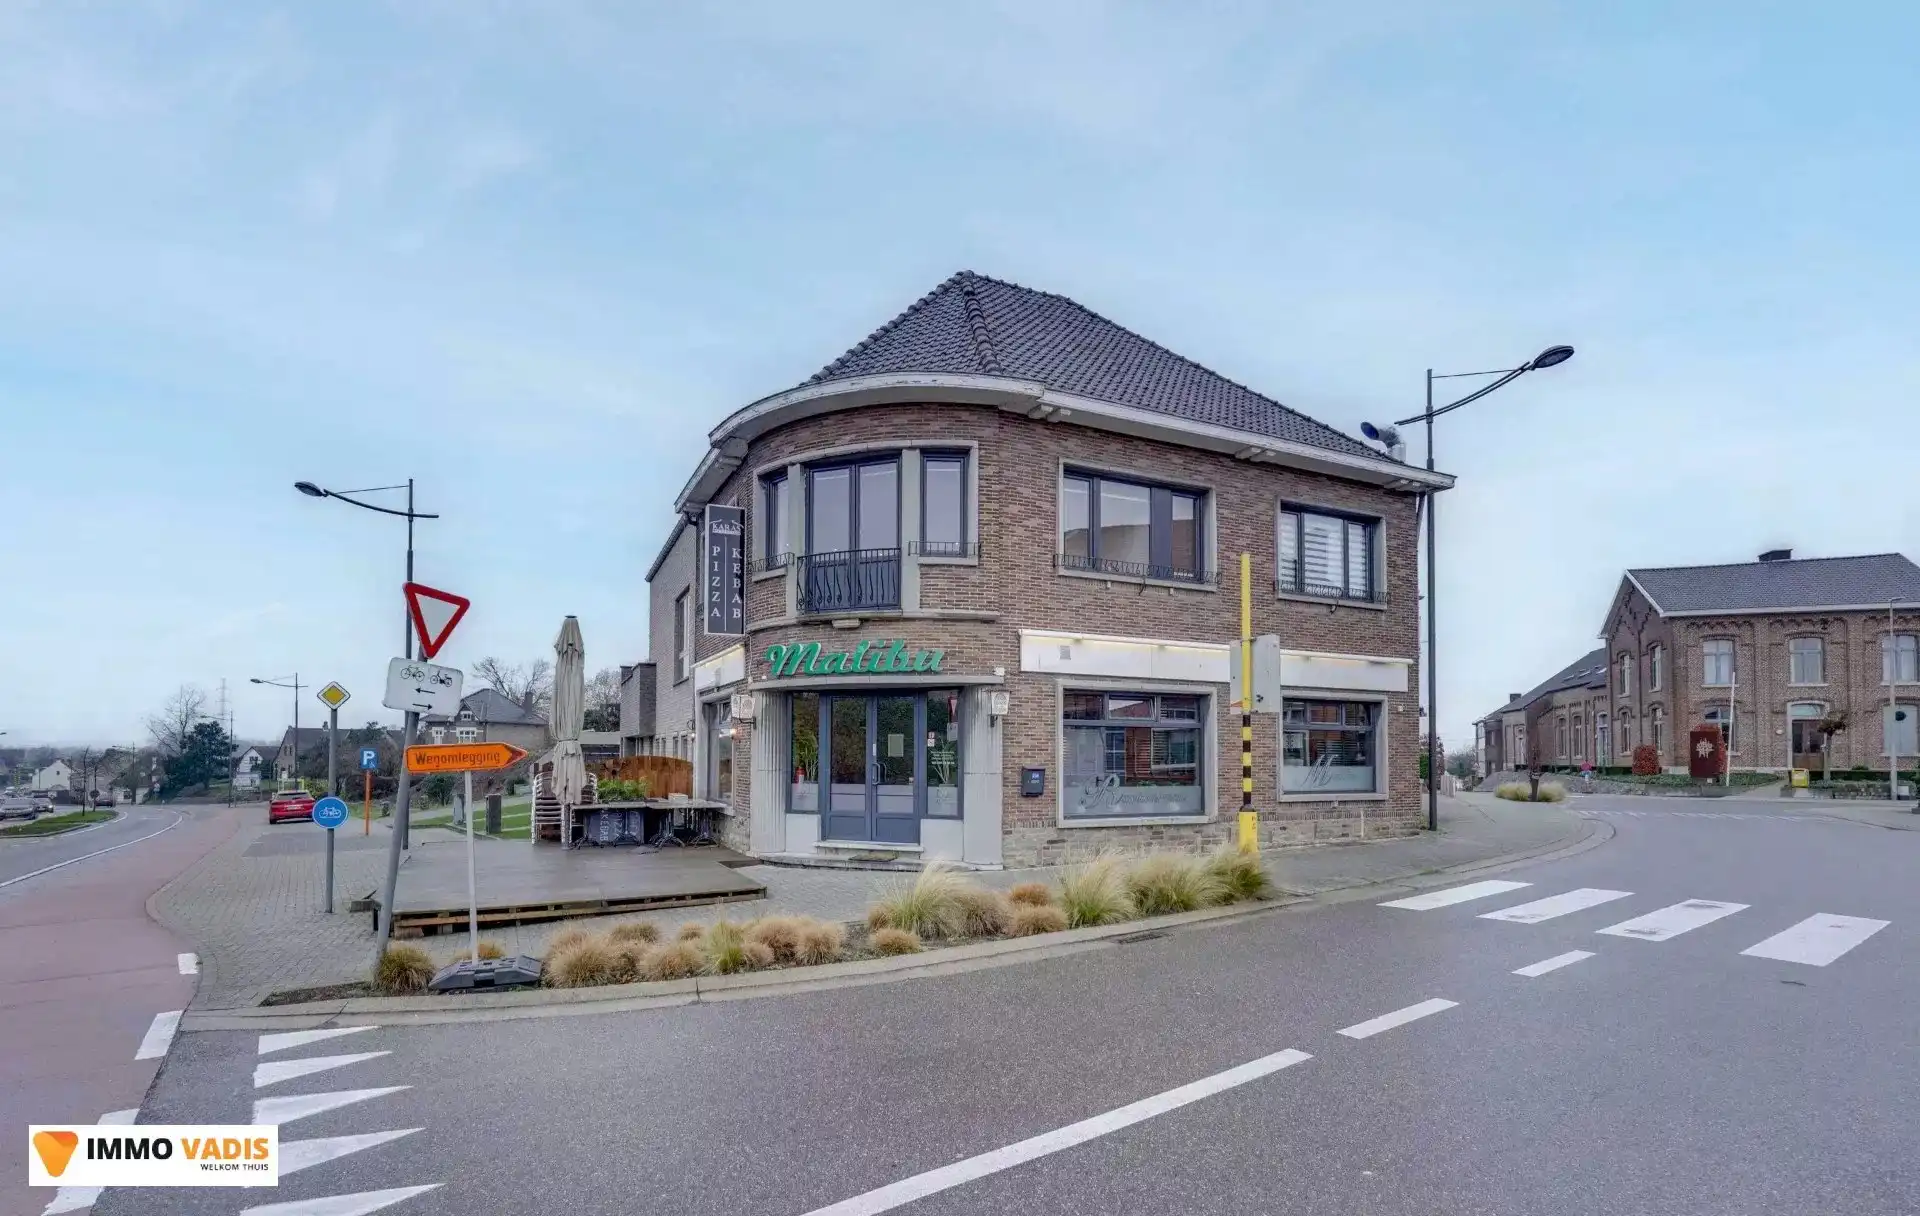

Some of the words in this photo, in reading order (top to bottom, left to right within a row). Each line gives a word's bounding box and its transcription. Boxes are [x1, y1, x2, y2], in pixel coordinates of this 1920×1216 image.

[711, 546, 721, 617] PIZZA
[732, 548, 742, 619] KEBAB
[764, 639, 944, 676] Malibu
[363, 751, 375, 765] P
[415, 752, 501, 767] Wegomlegging
